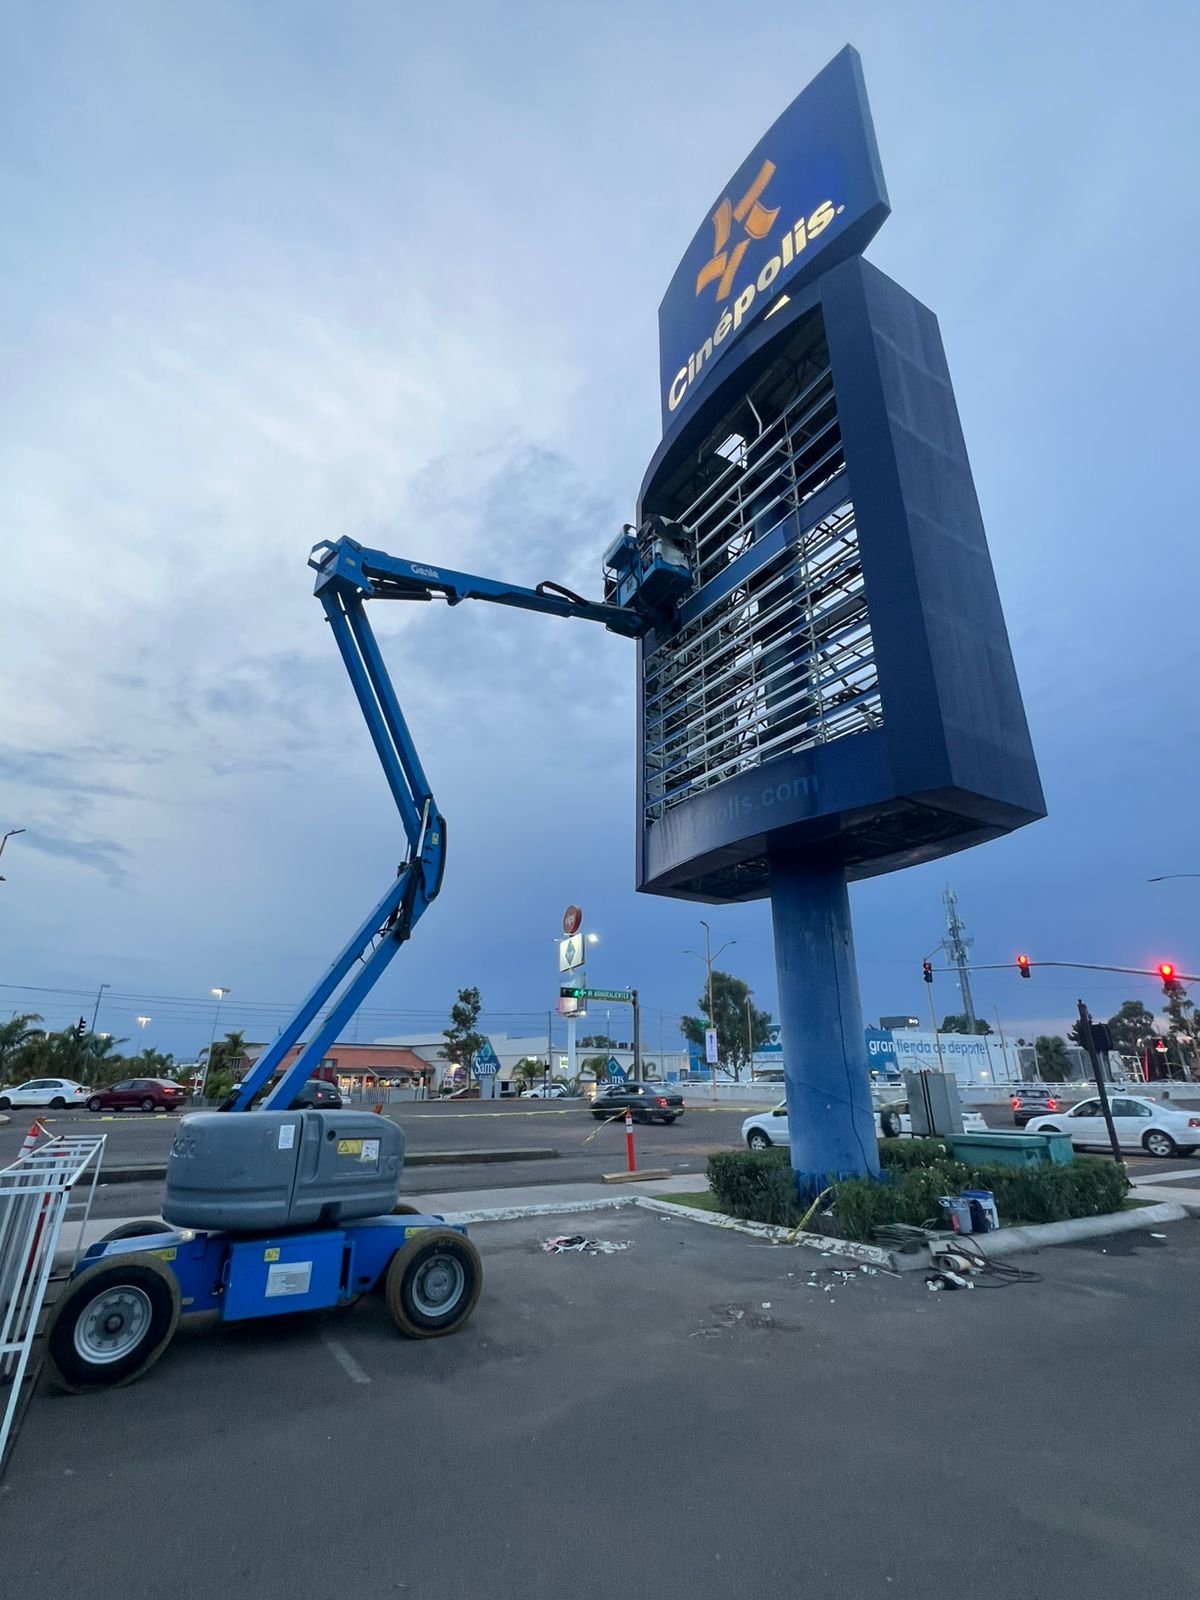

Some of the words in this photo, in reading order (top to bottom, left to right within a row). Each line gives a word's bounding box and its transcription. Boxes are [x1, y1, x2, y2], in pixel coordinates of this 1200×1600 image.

[668, 200, 835, 412] Cinépolis
[410, 564, 440, 579] Genie
[869, 1040, 896, 1055] gran
[896, 1039, 930, 1054] tienda
[933, 1040, 946, 1054] de
[949, 1041, 986, 1057] deporte
